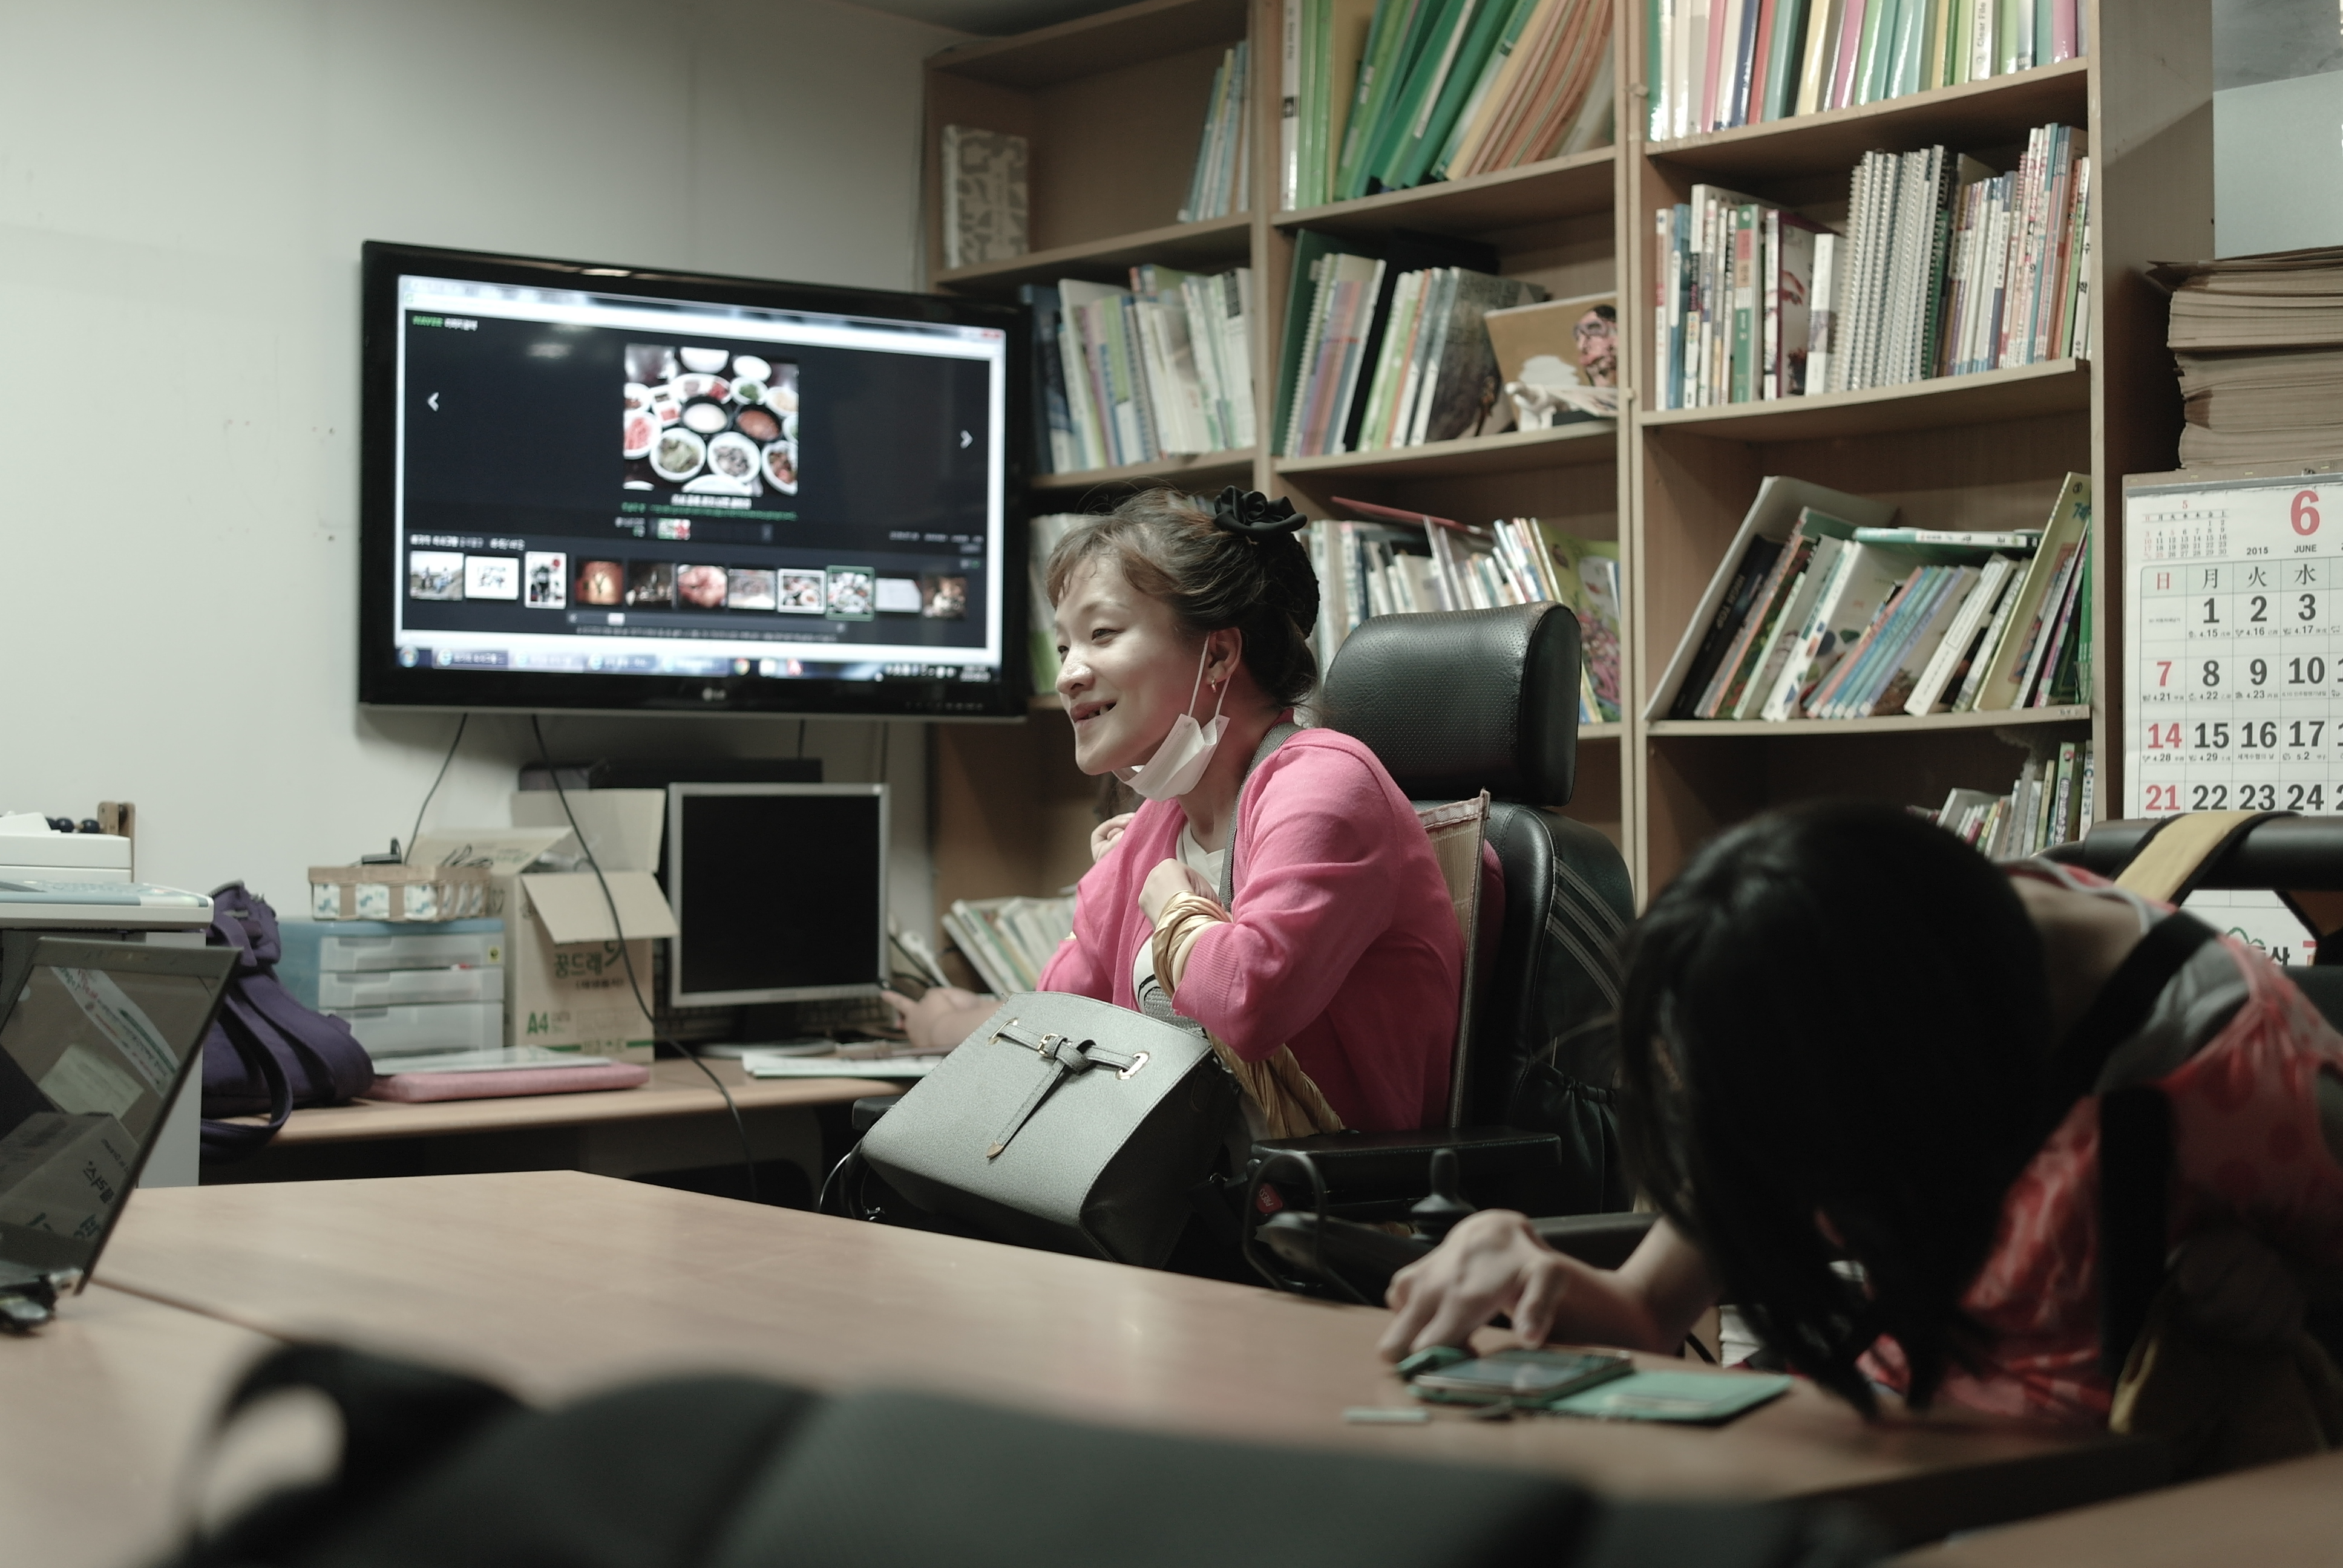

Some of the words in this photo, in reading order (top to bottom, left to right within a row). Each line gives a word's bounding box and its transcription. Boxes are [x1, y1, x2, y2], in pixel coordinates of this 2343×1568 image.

[1977, 22, 1985, 47] Clear
[2290, 489, 2320, 536] 6
[2246, 546, 2269, 555] 2015
[2294, 544, 2317, 554] JUNE
[2157, 572, 2170, 590] 日
[2202, 568, 2218, 590] 月
[2247, 566, 2267, 587] 火
[2294, 563, 2316, 586] 水
[2203, 598, 2220, 624] 1
[2250, 596, 2267, 622] 2
[2298, 593, 2316, 621] 3
[2246, 627, 2265, 636] 4.16
[2294, 625, 2314, 635] 4.17
[2157, 661, 2172, 687] 7
[2202, 660, 2220, 687] 8
[2250, 658, 2267, 685] 9
[2288, 656, 2325, 684] 10
[2246, 690, 2266, 699] 4.23
[2148, 723, 2182, 749] 14
[2194, 723, 2229, 749] 15
[2241, 722, 2277, 748] 16
[2288, 720, 2325, 747] 17
[2145, 785, 2180, 811] 21
[2192, 785, 2227, 811] 22
[2239, 784, 2276, 811] 23
[2287, 784, 2324, 811] 24
[526, 1011, 549, 1036] A4
[1259, 1187, 1274, 1207] PRESS
